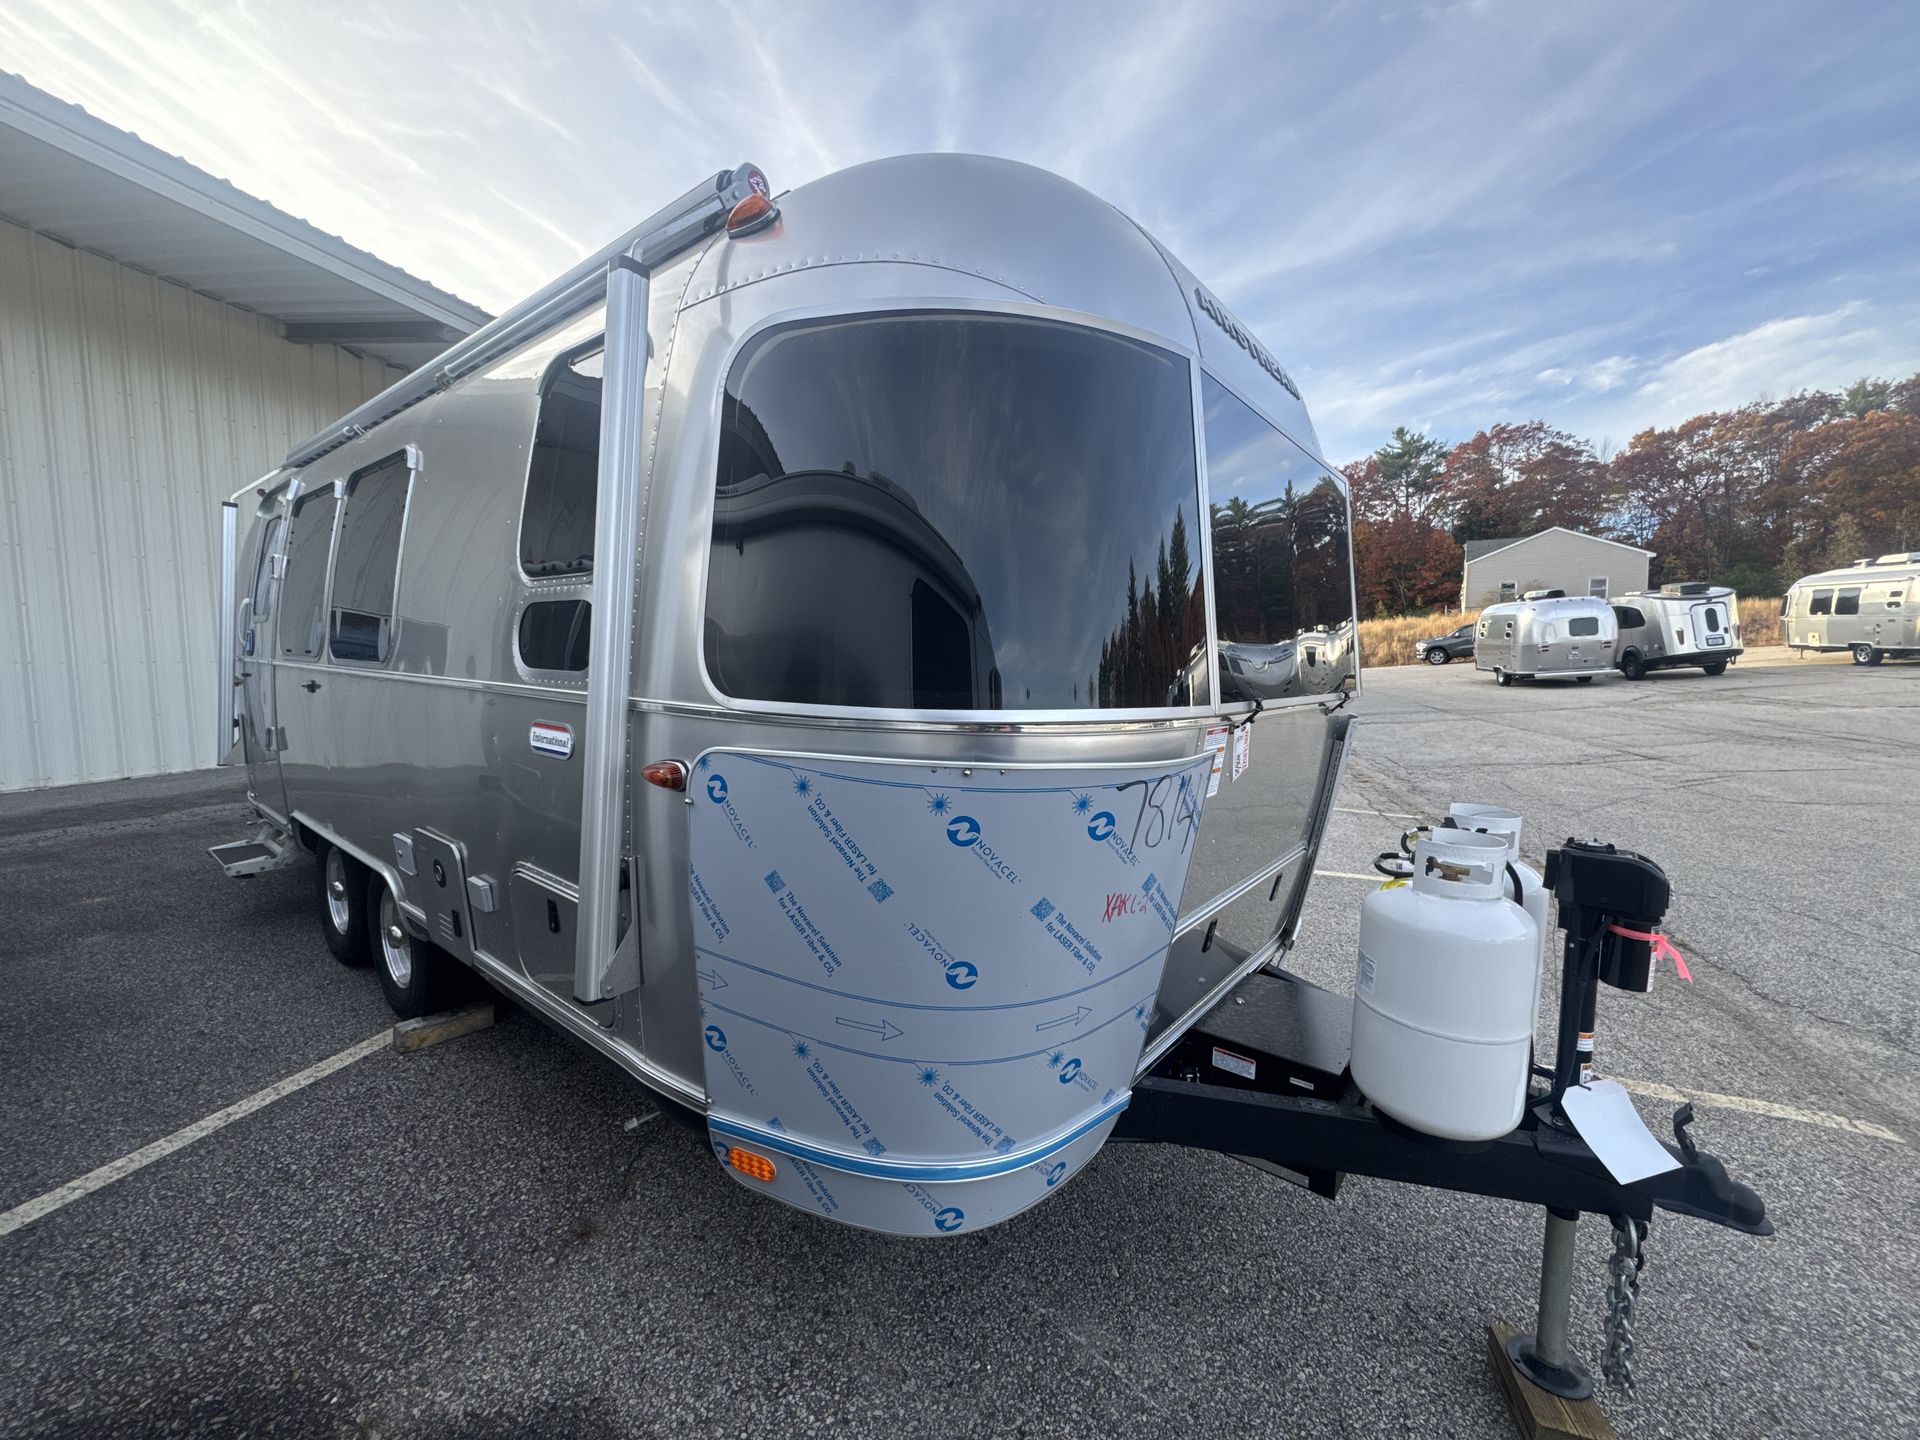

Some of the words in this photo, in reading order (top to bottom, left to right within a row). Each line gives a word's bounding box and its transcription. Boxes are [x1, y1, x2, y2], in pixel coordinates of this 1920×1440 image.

[532, 731, 570, 748] International
[725, 800, 755, 848] NOVACEL
[807, 805, 832, 838] Solution
[824, 810, 832, 818] &
[830, 818, 847, 838] Fiber
[829, 836, 856, 868] Novacel
[844, 837, 867, 863] LASER
[1111, 831, 1138, 866] NOVACEL
[854, 867, 867, 882] The
[865, 863, 878, 876] for
[976, 840, 1018, 884] NOVACEL
[694, 874, 712, 904] Novacel
[710, 904, 730, 934] Solution
[700, 902, 712, 921] Fiber
[778, 898, 787, 910] for
[786, 909, 806, 935] LASER
[804, 934, 820, 954] Fiber
[818, 954, 825, 962] &
[786, 890, 798, 906] The
[796, 906, 820, 936] Novacel
[817, 936, 842, 968] Solution
[1045, 922, 1056, 934] for
[1054, 930, 1074, 950] LASER
[1056, 912, 1066, 926] The
[1065, 922, 1088, 944] Novacel
[908, 922, 950, 968] NOVACEL
[724, 1050, 755, 1096] NOVACEL
[806, 1066, 830, 1098] Solution
[828, 1080, 843, 1100] Fiber
[827, 1097, 851, 1126] Novacel
[841, 1098, 862, 1123] LASER
[934, 1092, 960, 1118] Solution
[958, 1098, 976, 1114] Fiber
[850, 1125, 862, 1140] The
[860, 1122, 872, 1134] for
[957, 1115, 983, 1137] Novacel
[973, 1112, 994, 1130] LASER
[993, 1126, 1004, 1137] for
[982, 1134, 994, 1146] The
[816, 1180, 839, 1210] Solution
[902, 1182, 938, 1214] NOVACE
